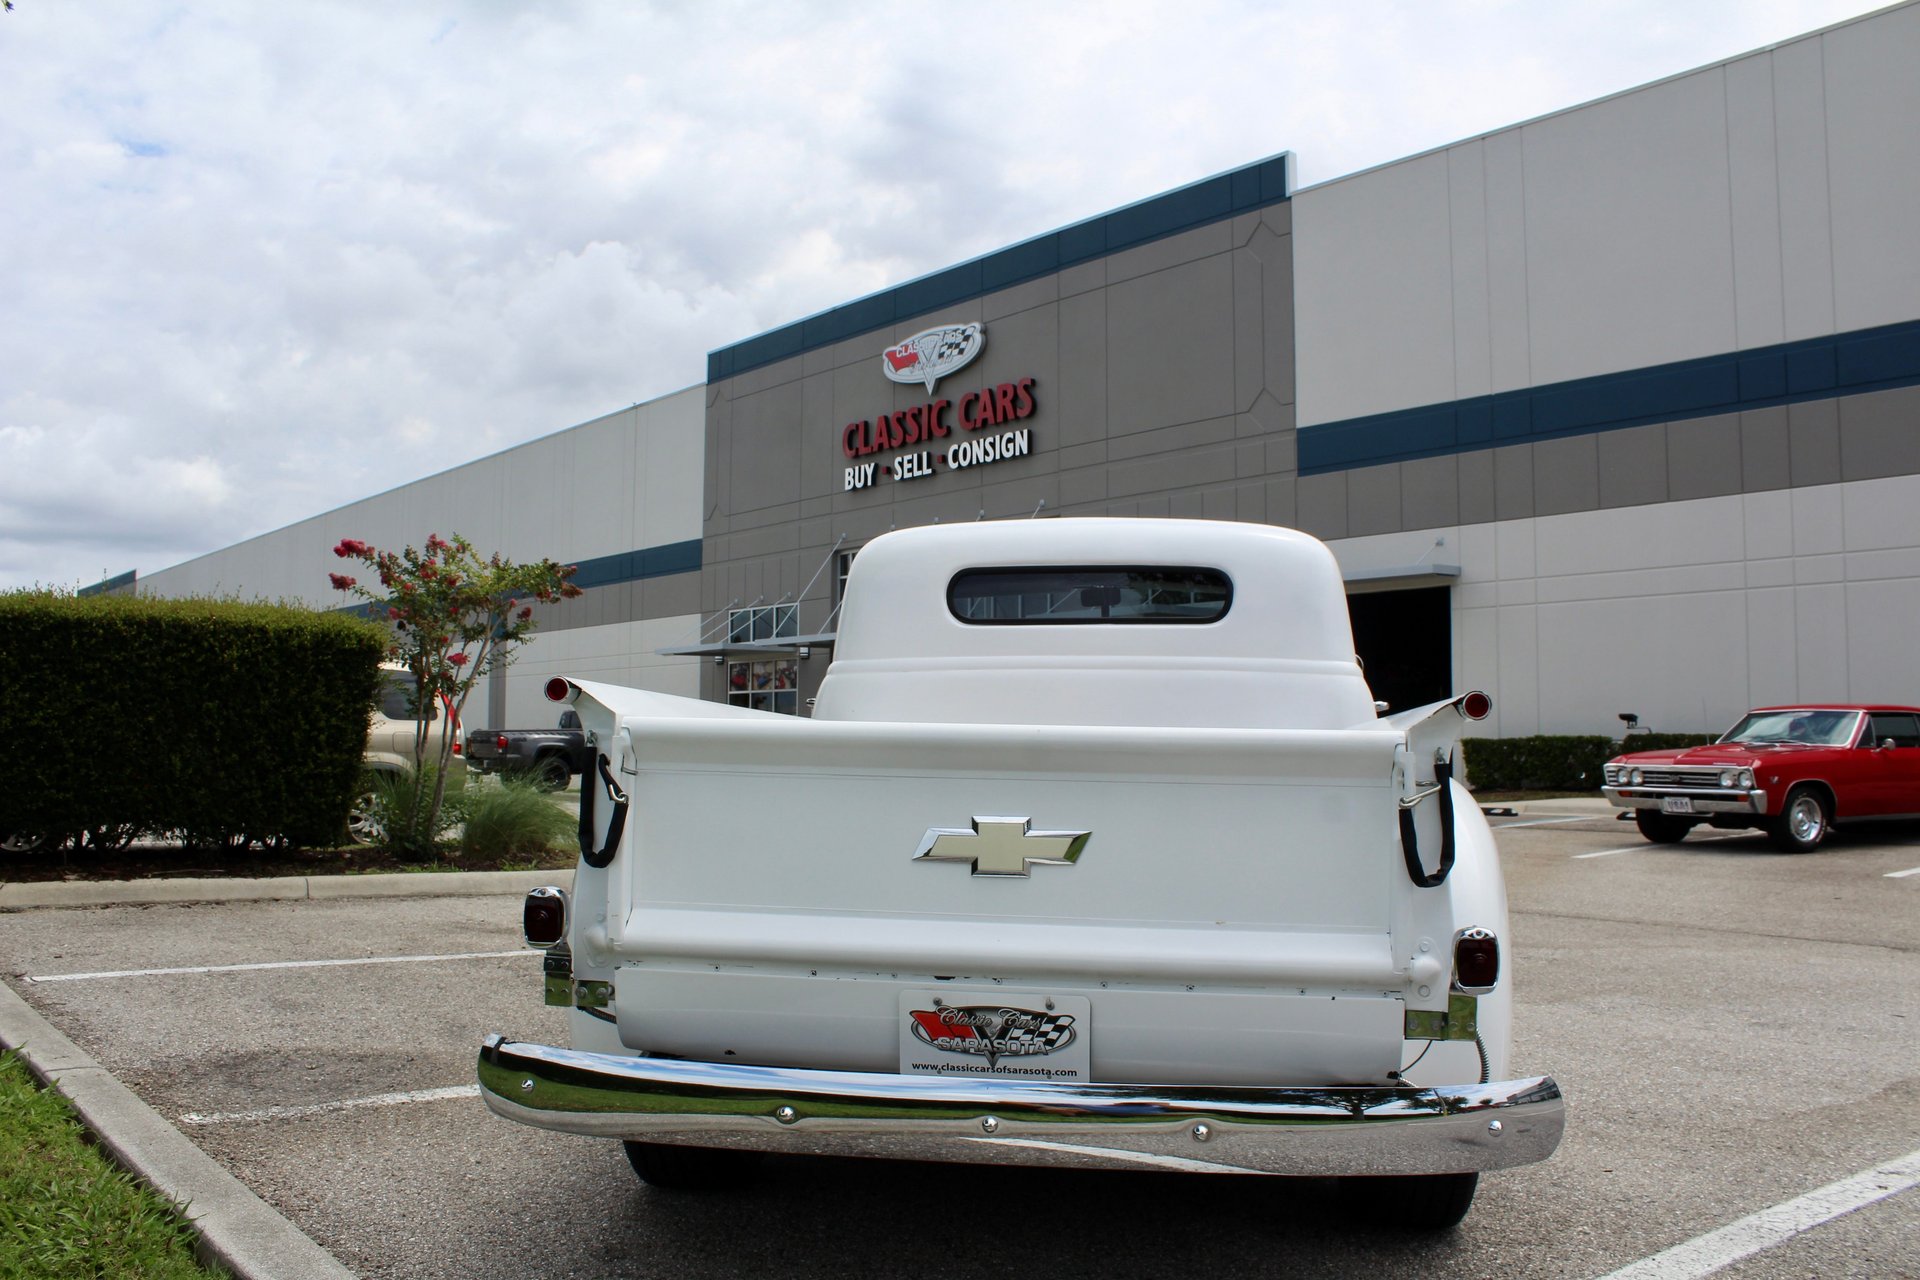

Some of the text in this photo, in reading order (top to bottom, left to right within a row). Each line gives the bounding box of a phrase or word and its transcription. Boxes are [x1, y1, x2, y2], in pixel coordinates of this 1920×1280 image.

[842, 377, 1034, 459] CLASSIC CARS
[844, 428, 1029, 491] BUY SELL CONSIGN
[935, 1004, 1041, 1030] Classic Cars
[937, 1036, 1049, 1056] SARASOTA
[911, 1062, 1078, 1077] www.classiccarsofsarasota.com
